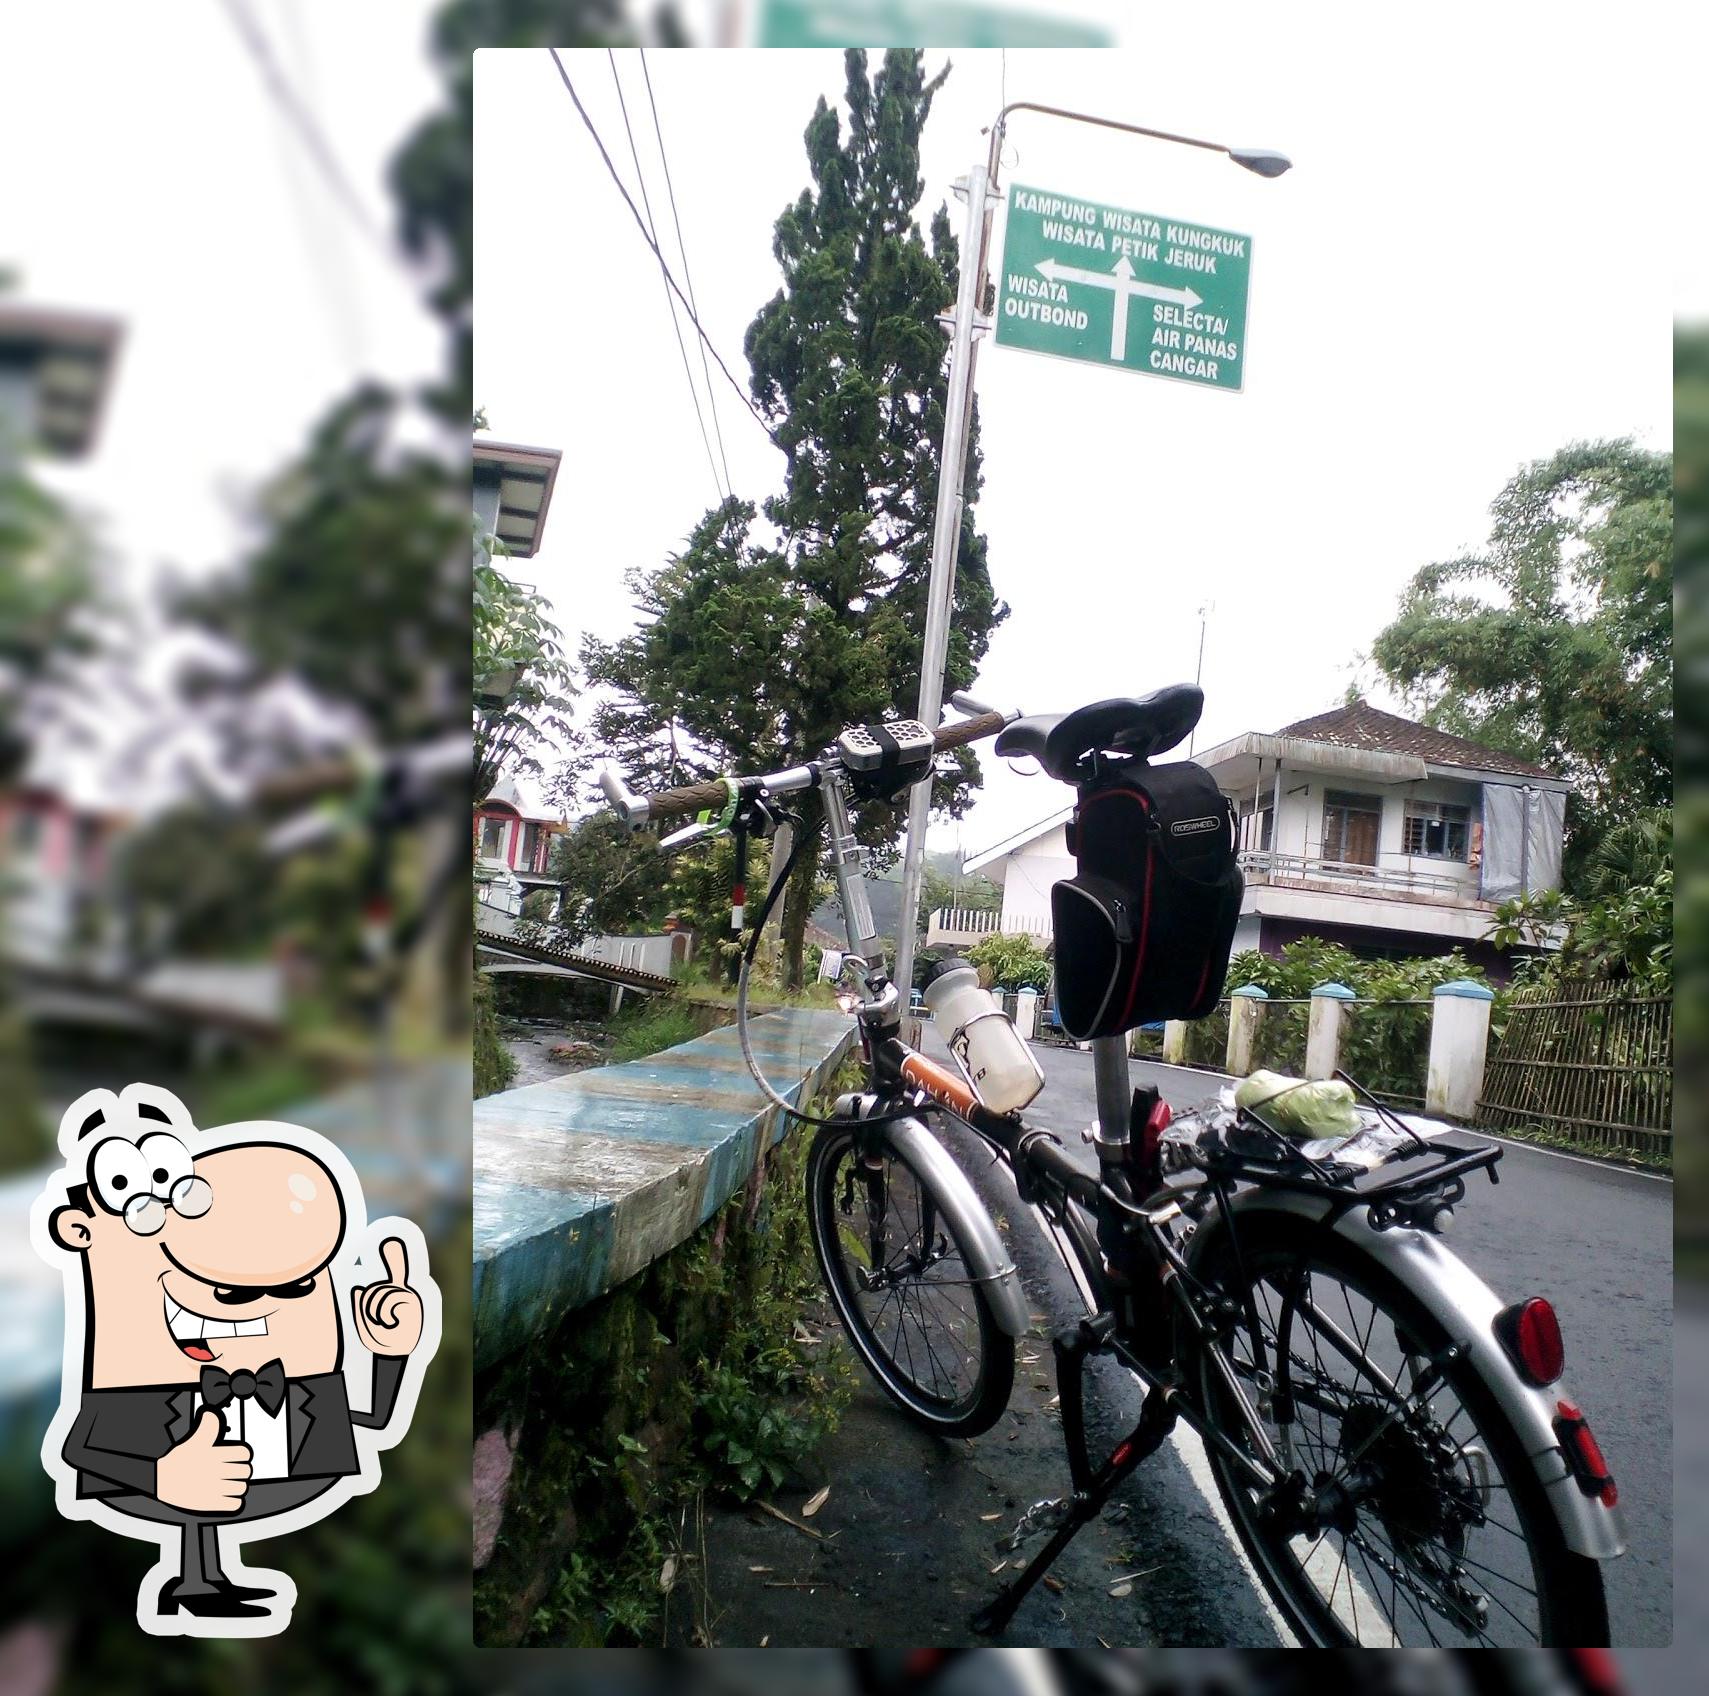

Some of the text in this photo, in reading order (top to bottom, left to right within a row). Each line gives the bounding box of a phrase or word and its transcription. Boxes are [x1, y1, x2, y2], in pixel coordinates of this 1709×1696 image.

[1015, 191, 1245, 258] KAMPUNG WISATA KUNGKUK
[1042, 220, 1217, 274] WISATA PETIK JERUK
[1008, 273, 1068, 303] WISATA
[1005, 297, 1088, 330] OUTBOND
[1153, 304, 1229, 335] SELECTA/
[1152, 327, 1237, 361] AIR PANAS
[1150, 350, 1218, 380] CANGAR
[1174, 820, 1216, 832] ROSWHEEL
